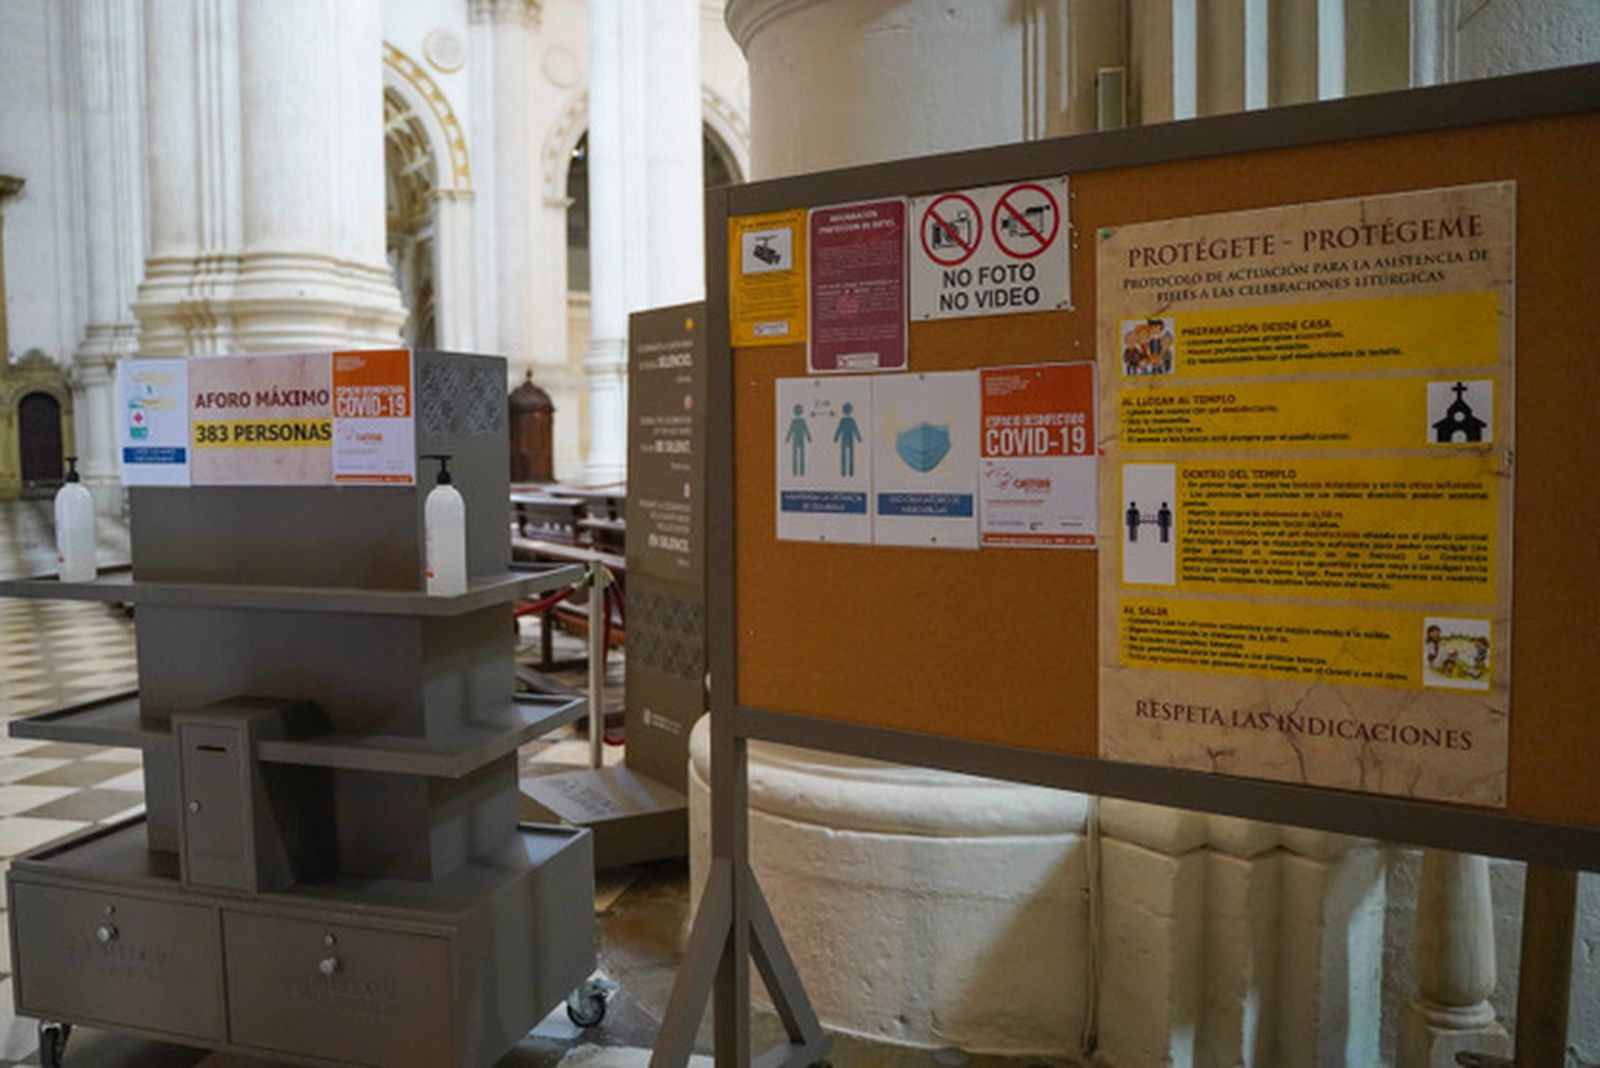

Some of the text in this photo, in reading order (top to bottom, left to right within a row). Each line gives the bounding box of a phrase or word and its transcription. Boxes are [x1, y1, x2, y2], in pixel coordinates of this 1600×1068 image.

[1128, 234, 1275, 269] PROTÉGETE
[1303, 213, 1483, 252] PROTÉGEME
[944, 263, 1036, 289] NO FOTO
[1122, 249, 1489, 290] PROTOCOLO DE ACTUACIÓN PARA LA ASISTENCIA DE
[940, 286, 1040, 311] NO VIDEO
[1157, 289, 1197, 302] FIELES
[1200, 288, 1208, 299] A
[1212, 287, 1234, 298] LAS
[1238, 277, 1350, 295] CELEBRACIONES
[1301, 319, 1332, 330] CASA
[195, 391, 250, 410] AFORO
[255, 384, 330, 408] MÁXIMO
[337, 394, 406, 417] COVID-19
[196, 424, 229, 443] 383
[234, 421, 332, 442] PERSONAS
[986, 425, 1086, 455] COVID-19
[1252, 469, 1297, 479] TEMPLO
[1135, 699, 1473, 751] RESPETA LAS INDICACIONES
